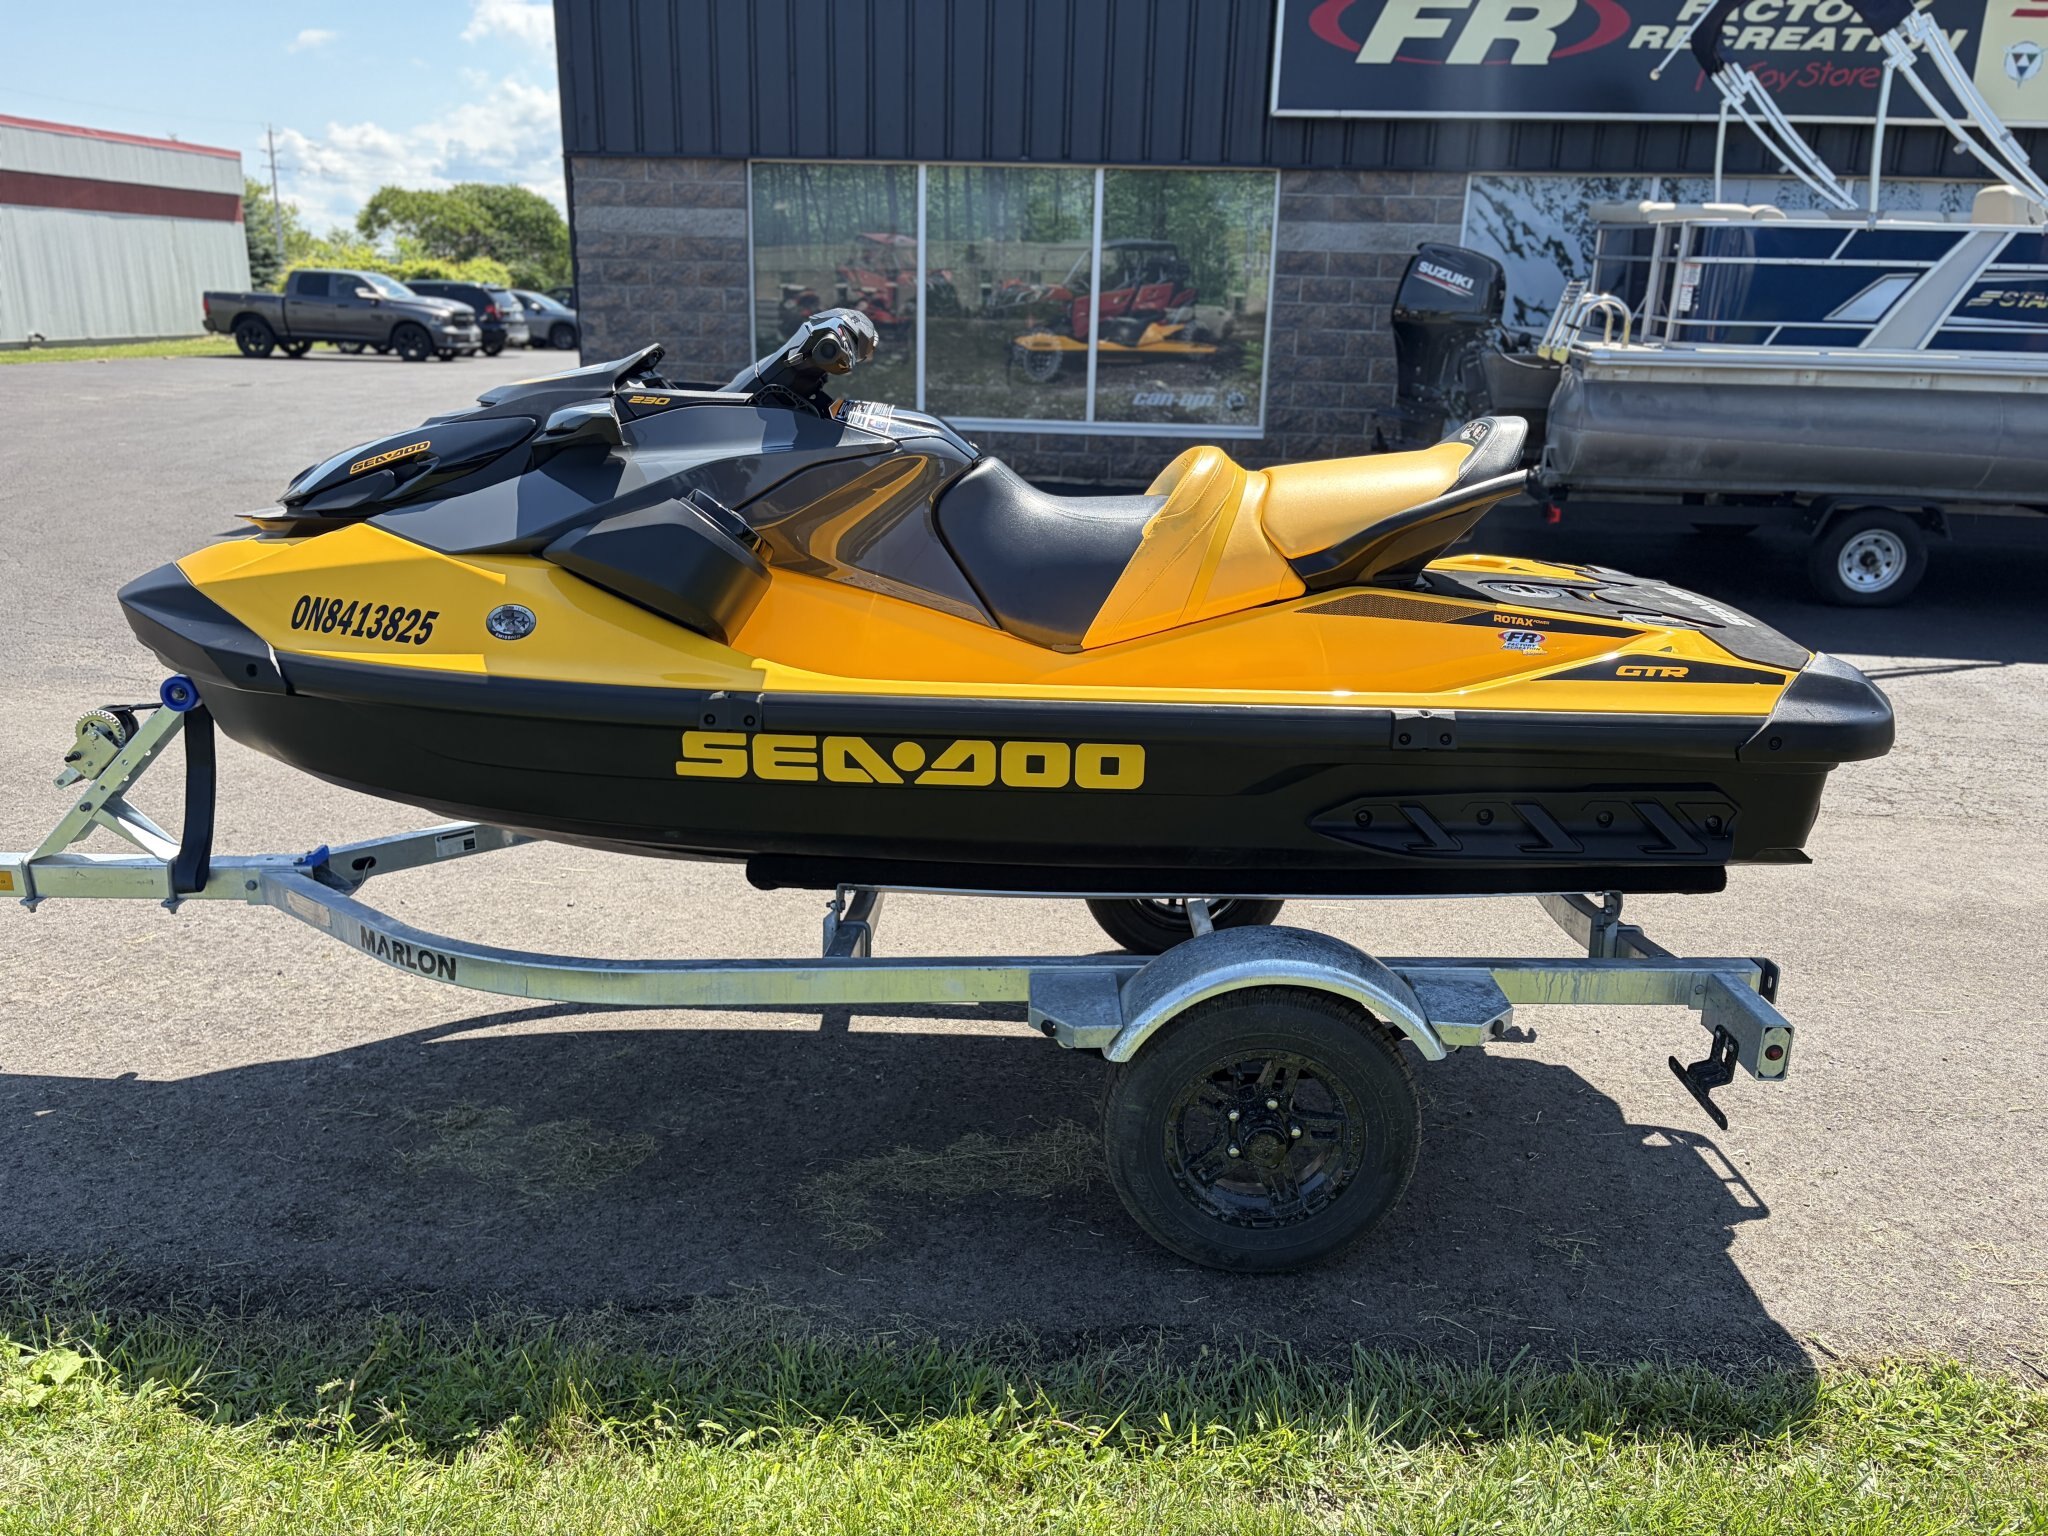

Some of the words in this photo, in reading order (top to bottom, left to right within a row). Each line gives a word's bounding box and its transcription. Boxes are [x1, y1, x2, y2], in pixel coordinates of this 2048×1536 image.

[1354, 0, 1578, 65] FR
[1797, 60, 1881, 88] Store
[1418, 261, 1475, 289] SUZUKI
[628, 395, 671, 405] 230
[291, 595, 440, 645] ON8413825
[1493, 614, 1533, 626] ROTAX
[1507, 632, 1538, 643] FR
[1615, 665, 1690, 678] GTR
[360, 924, 457, 981] MARLON
